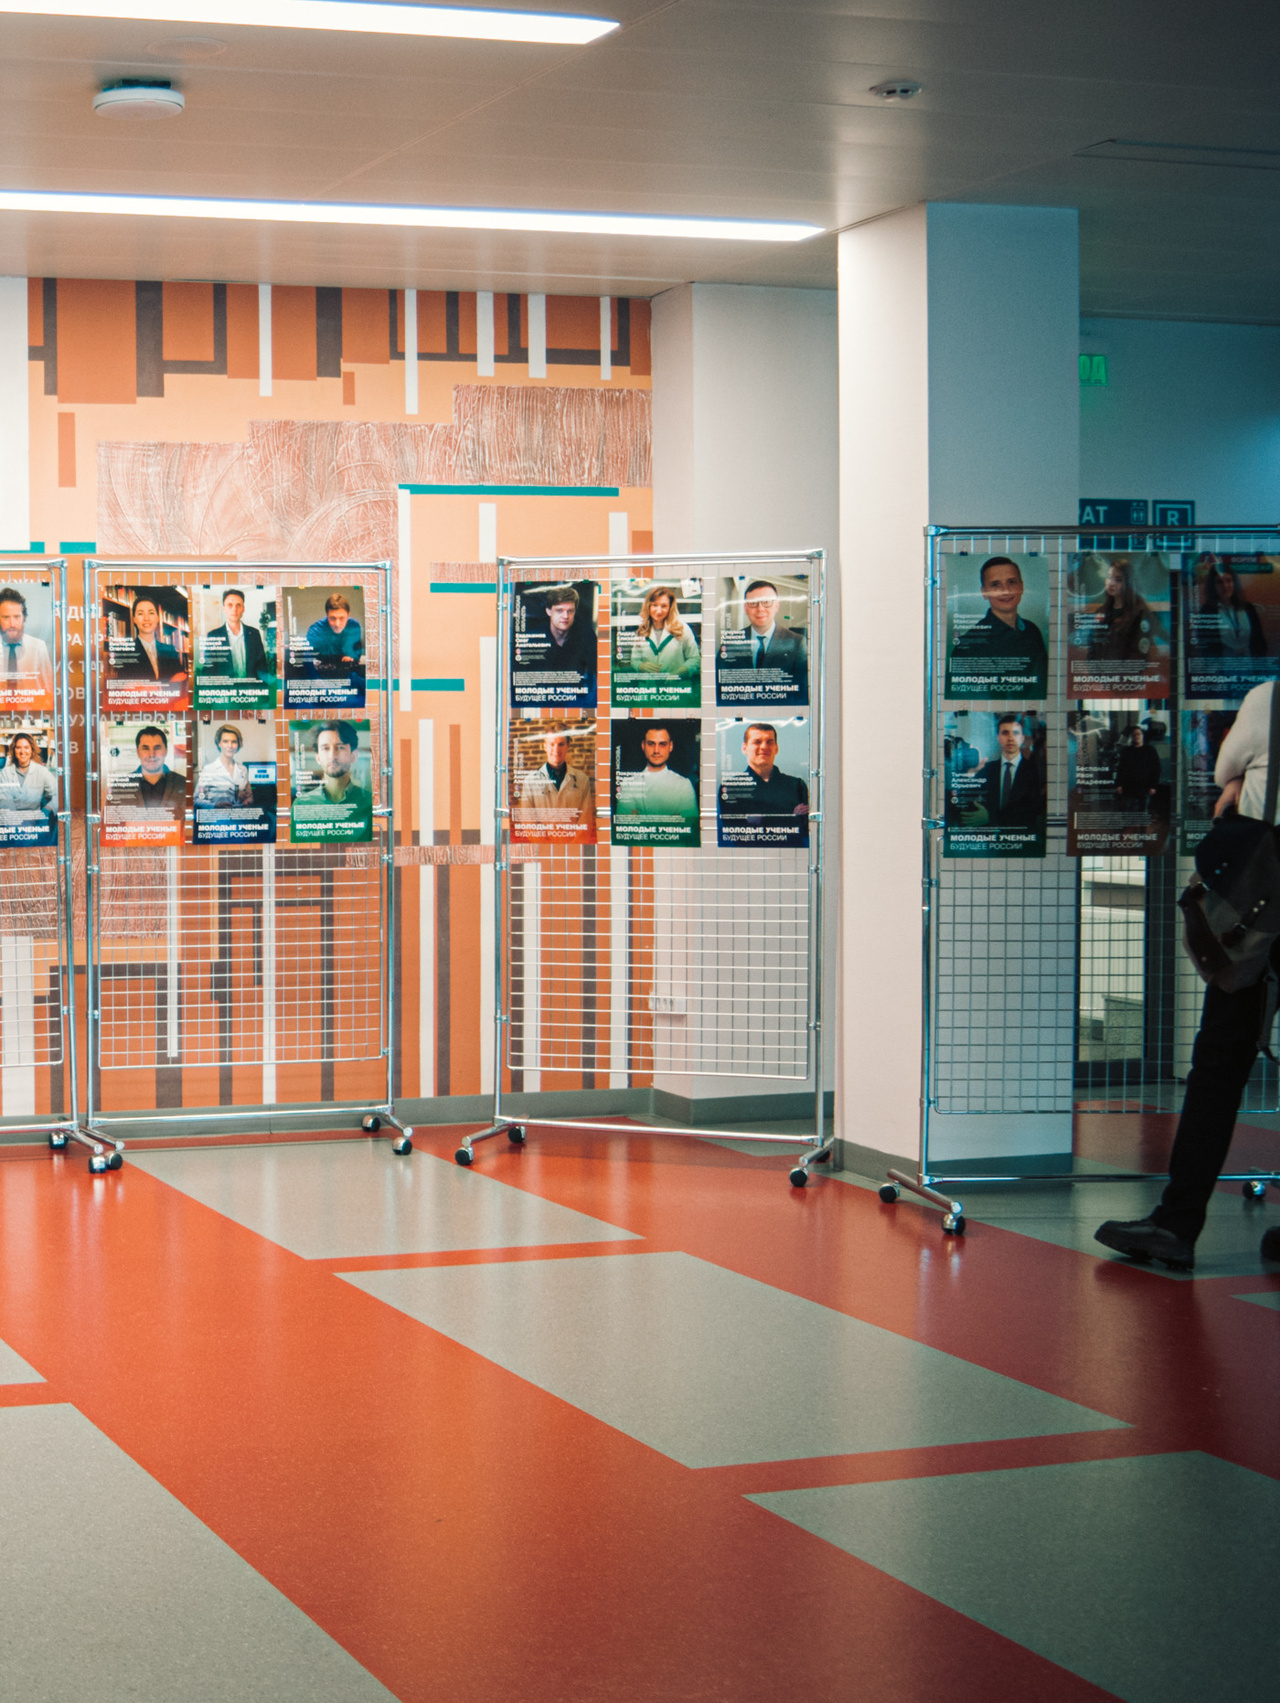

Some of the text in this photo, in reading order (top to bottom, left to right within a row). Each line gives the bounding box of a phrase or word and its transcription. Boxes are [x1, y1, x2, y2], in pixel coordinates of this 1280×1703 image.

[951, 676, 998, 684] МОЛОДЫЕ
[1191, 676, 1237, 684] МОЛОДЫЕ
[149, 689, 180, 697] УЧЕНЫЕ
[289, 689, 326, 697] МОЛОДЫЕ
[515, 687, 554, 695] МОЛОДЫЕ
[617, 686, 691, 695] МОЛОДЫЕ УЧЕНЫЕ
[106, 825, 144, 833] МОЛОДЫЕ
[616, 826, 656, 834] МОЛОДЫЕ
[106, 833, 136, 841] БУДУЩЕЕ
[950, 834, 996, 842] МОЛОДЫЕ
[1077, 833, 1120, 841] МОЛОДЫЕ
[950, 843, 986, 851] БУДУЩЕЕ
